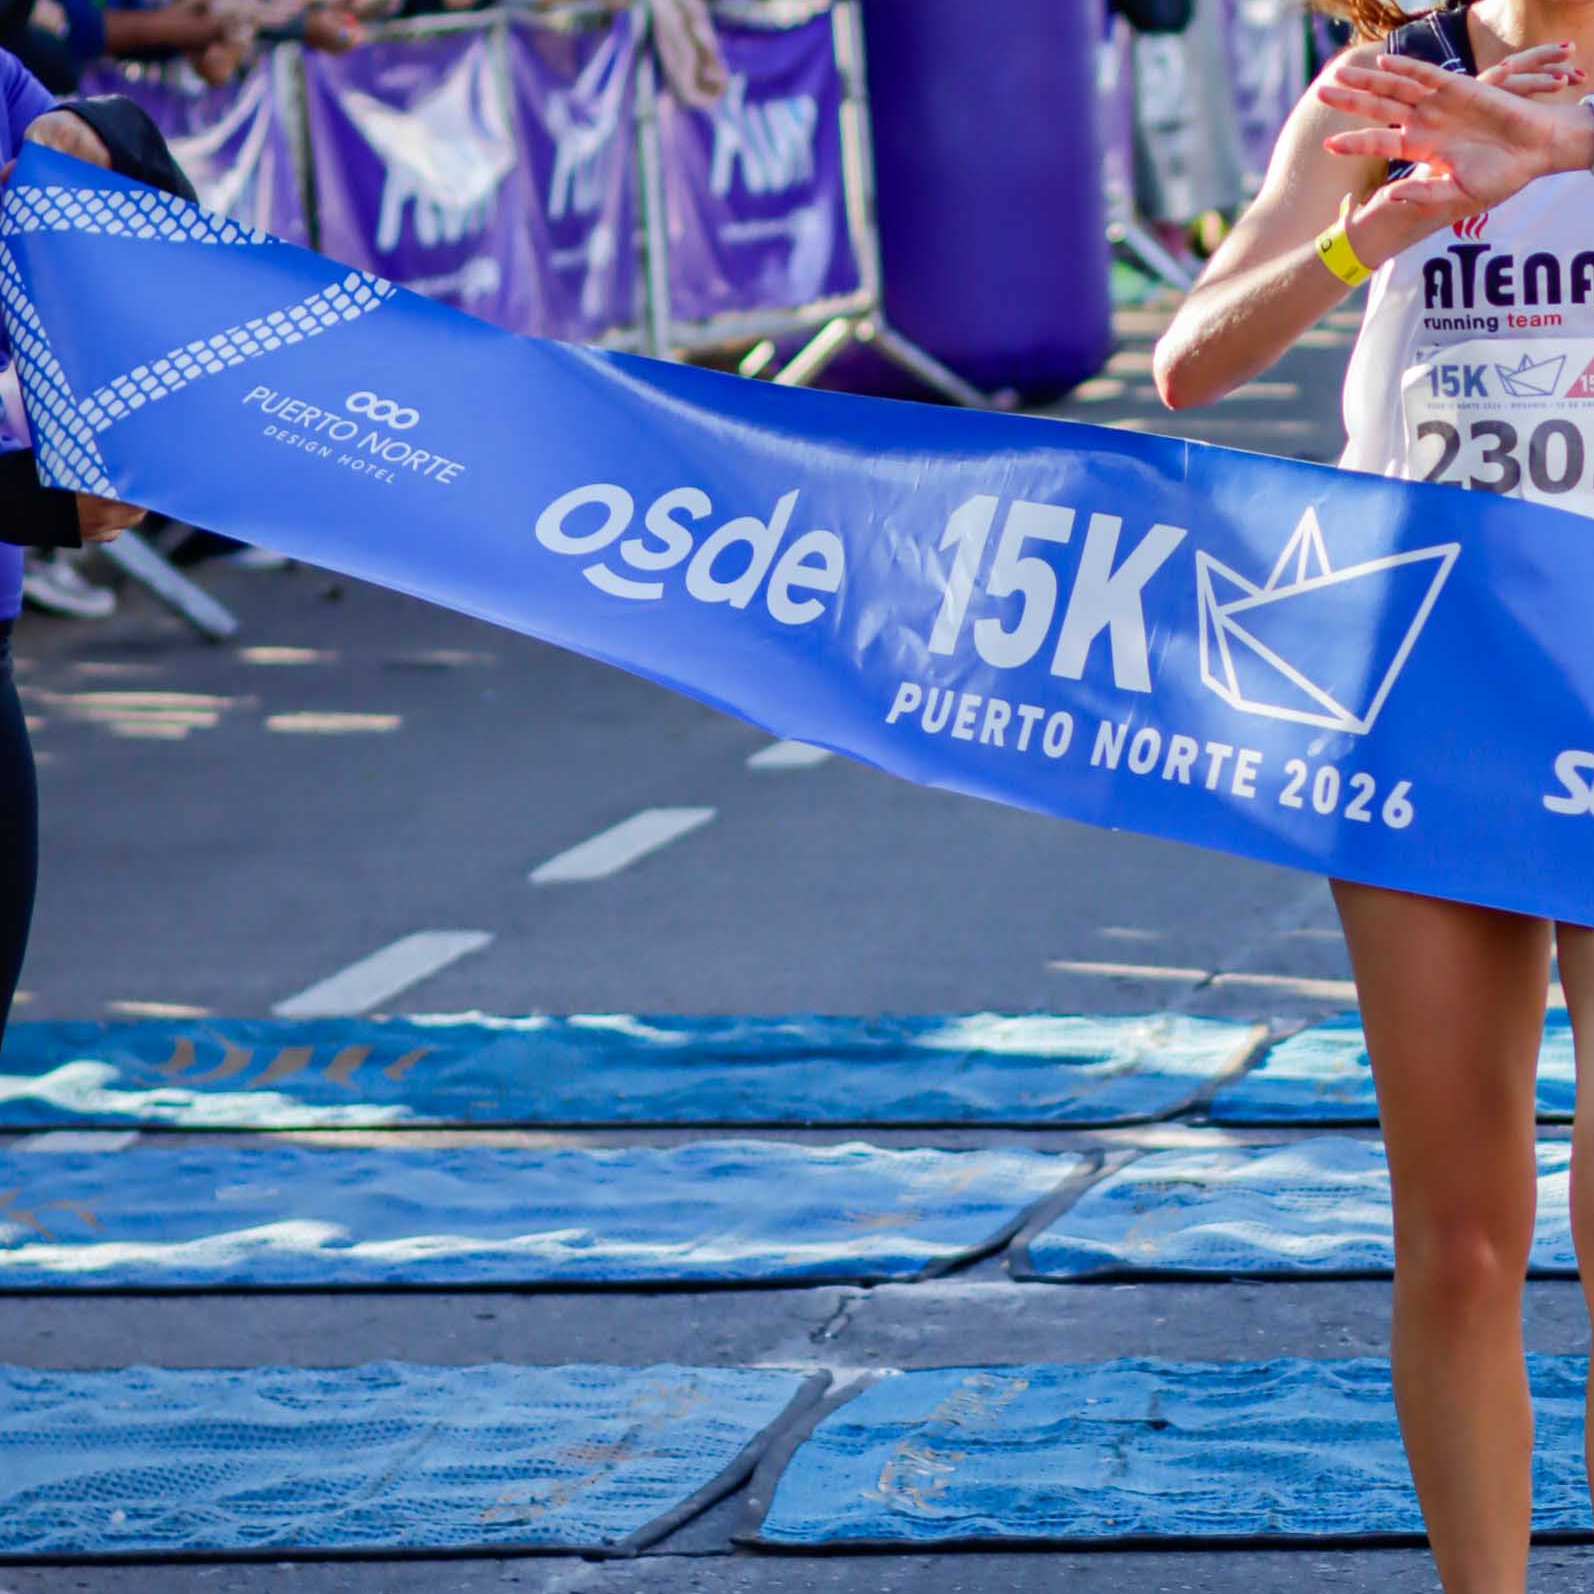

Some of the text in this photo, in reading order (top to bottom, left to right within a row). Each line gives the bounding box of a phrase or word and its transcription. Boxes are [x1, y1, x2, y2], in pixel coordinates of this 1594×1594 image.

[1423, 312, 1563, 333] running team
[1425, 364, 1489, 398] 15K
[243, 385, 467, 485] PUERTO NORTE
[263, 424, 397, 485] DESIGN HOTEL
[534, 482, 847, 626] osde
[926, 493, 1189, 693] 15K
[885, 681, 1415, 830] PUERTO NORTE 2026
